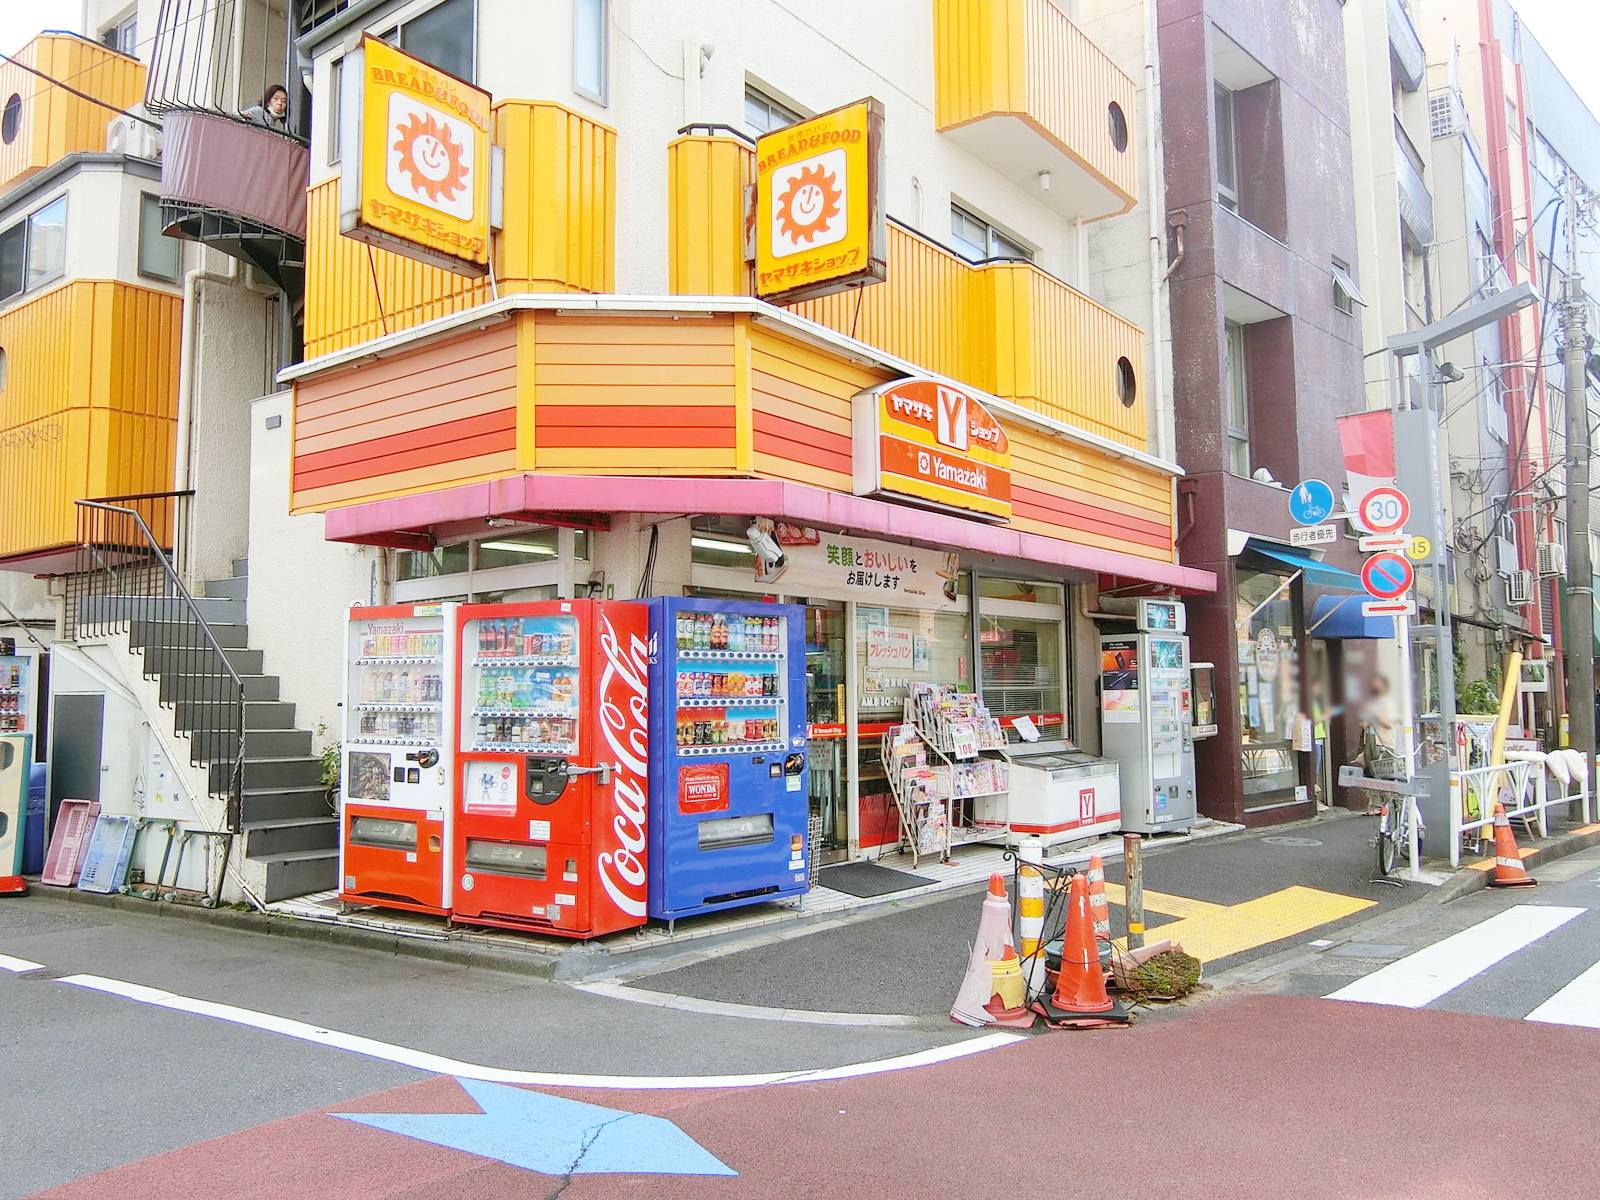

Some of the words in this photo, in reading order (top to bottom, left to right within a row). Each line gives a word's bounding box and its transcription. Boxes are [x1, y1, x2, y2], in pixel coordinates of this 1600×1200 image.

[757, 128, 862, 173] BREAD&FOOD
[760, 246, 861, 284] ヤマザキショップ
[891, 394, 934, 422] ヤマザキ
[970, 420, 1000, 443] ショップ
[932, 455, 988, 490] Yamazaki
[1370, 499, 1398, 521] 30
[1292, 529, 1334, 543] 歩行者優先
[826, 544, 917, 574] 笑顔とおいしいを
[846, 571, 900, 590] お届けします
[367, 622, 404, 635] Yamazaki
[869, 644, 911, 659] フレッシュパン
[958, 743, 973, 756] 108
[688, 784, 717, 795] WONDA
